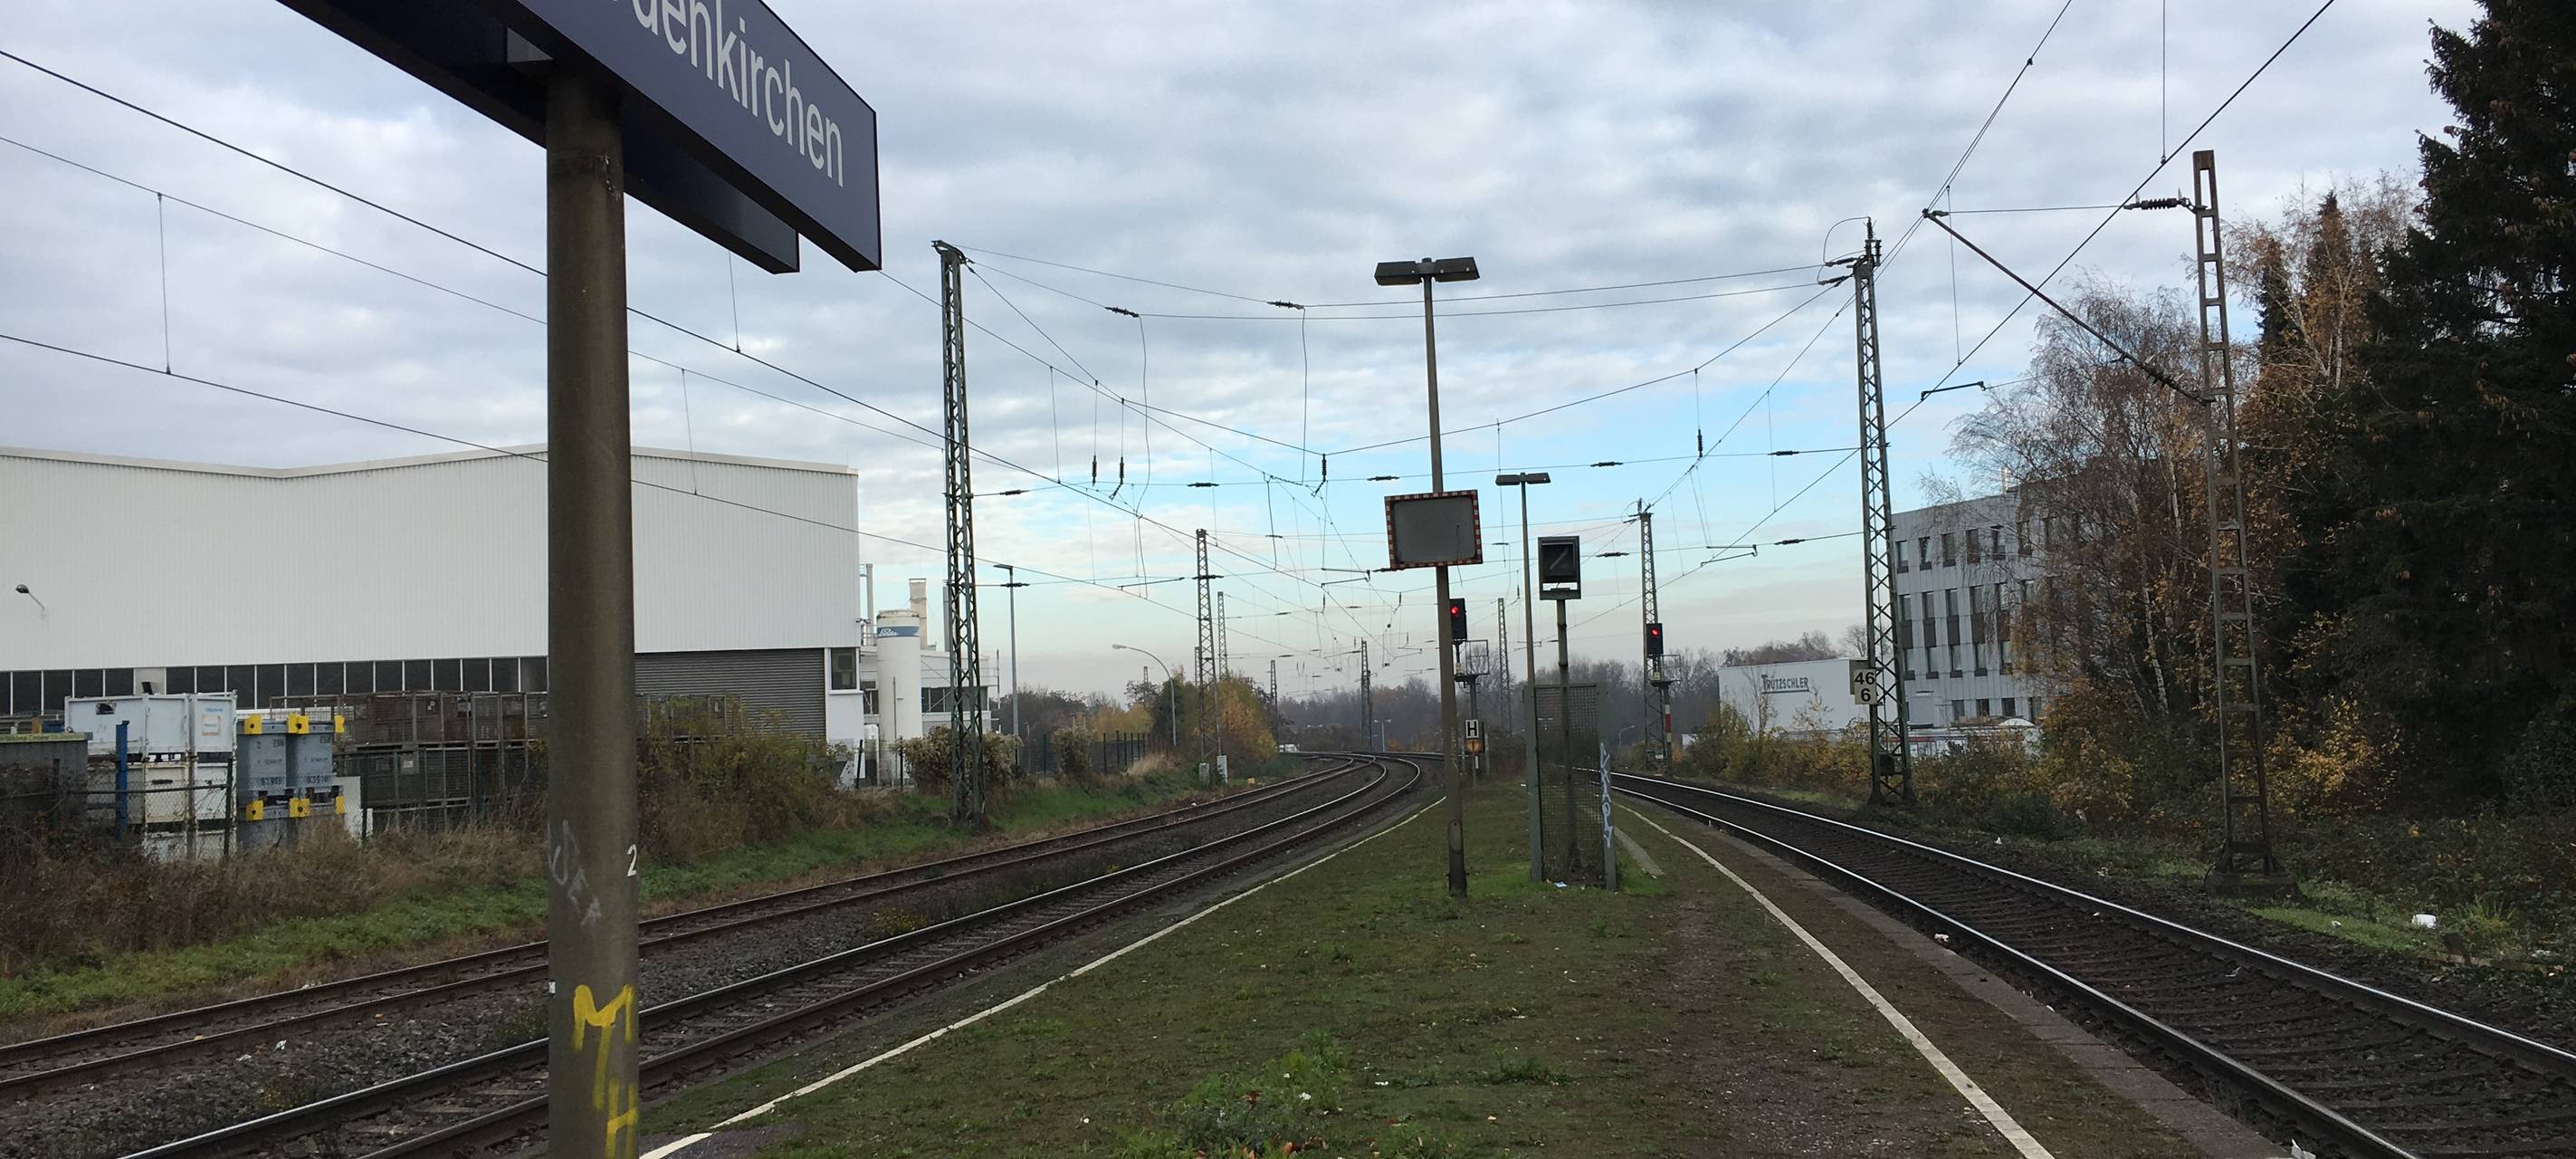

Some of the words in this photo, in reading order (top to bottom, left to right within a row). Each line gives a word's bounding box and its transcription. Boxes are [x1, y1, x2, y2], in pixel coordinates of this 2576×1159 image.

[615, 0, 844, 187] enkirchen
[1855, 672, 1875, 685] 46
[1861, 688, 1871, 702] 6
[1466, 721, 1478, 737] H
[627, 844, 637, 876] 2
